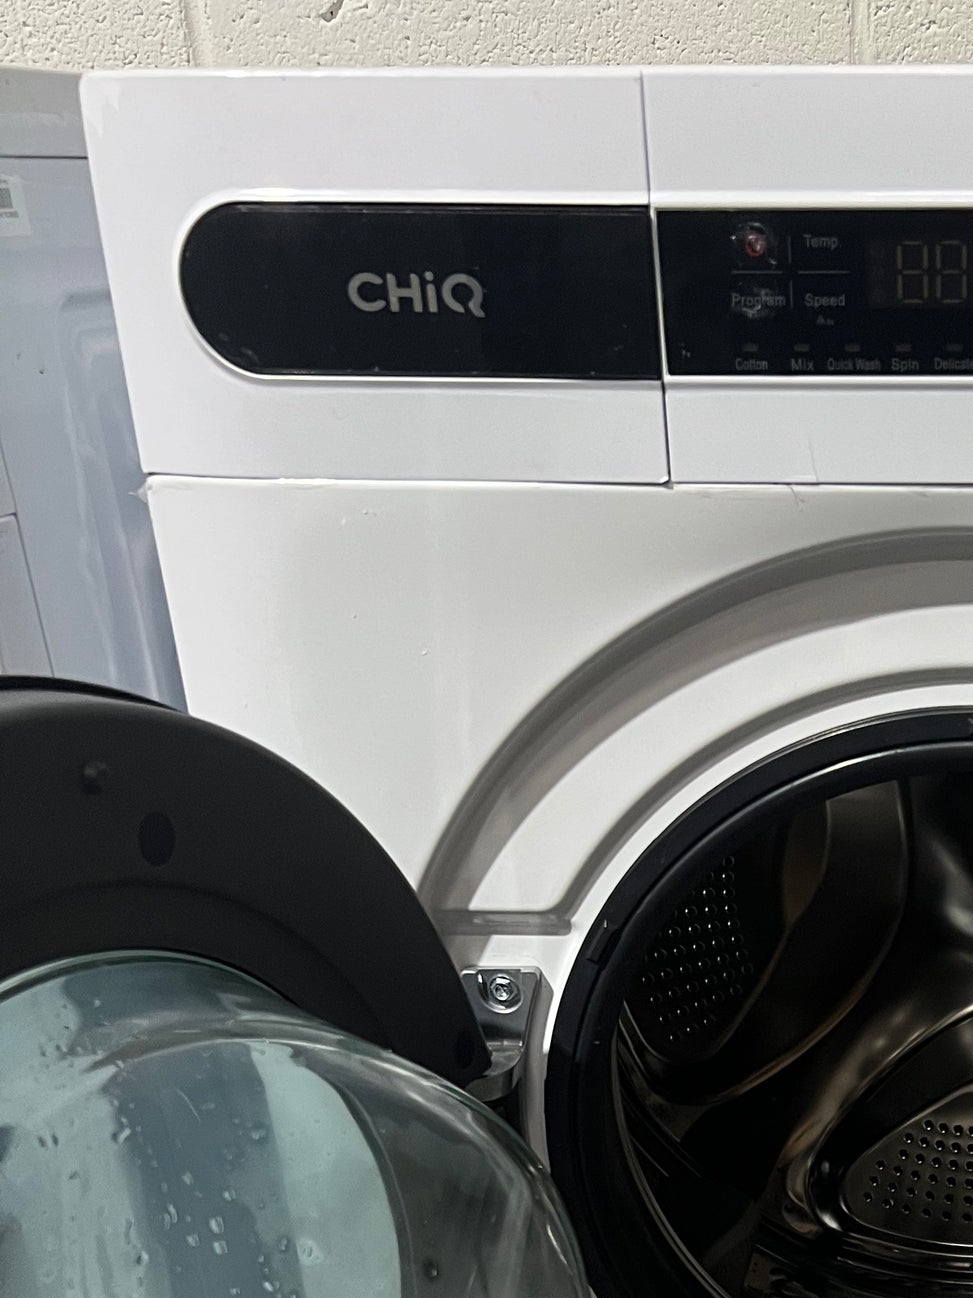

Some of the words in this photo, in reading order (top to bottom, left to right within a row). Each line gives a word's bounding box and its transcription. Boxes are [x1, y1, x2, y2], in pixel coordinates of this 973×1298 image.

[347, 271, 486, 318] CHiQ
[731, 292, 786, 309] Program
[804, 293, 846, 308] Speed
[735, 358, 769, 371] Cotton
[791, 358, 815, 371] Mix
[827, 358, 854, 371] Quick
[855, 358, 881, 371] Wash
[891, 358, 919, 372] Spin
